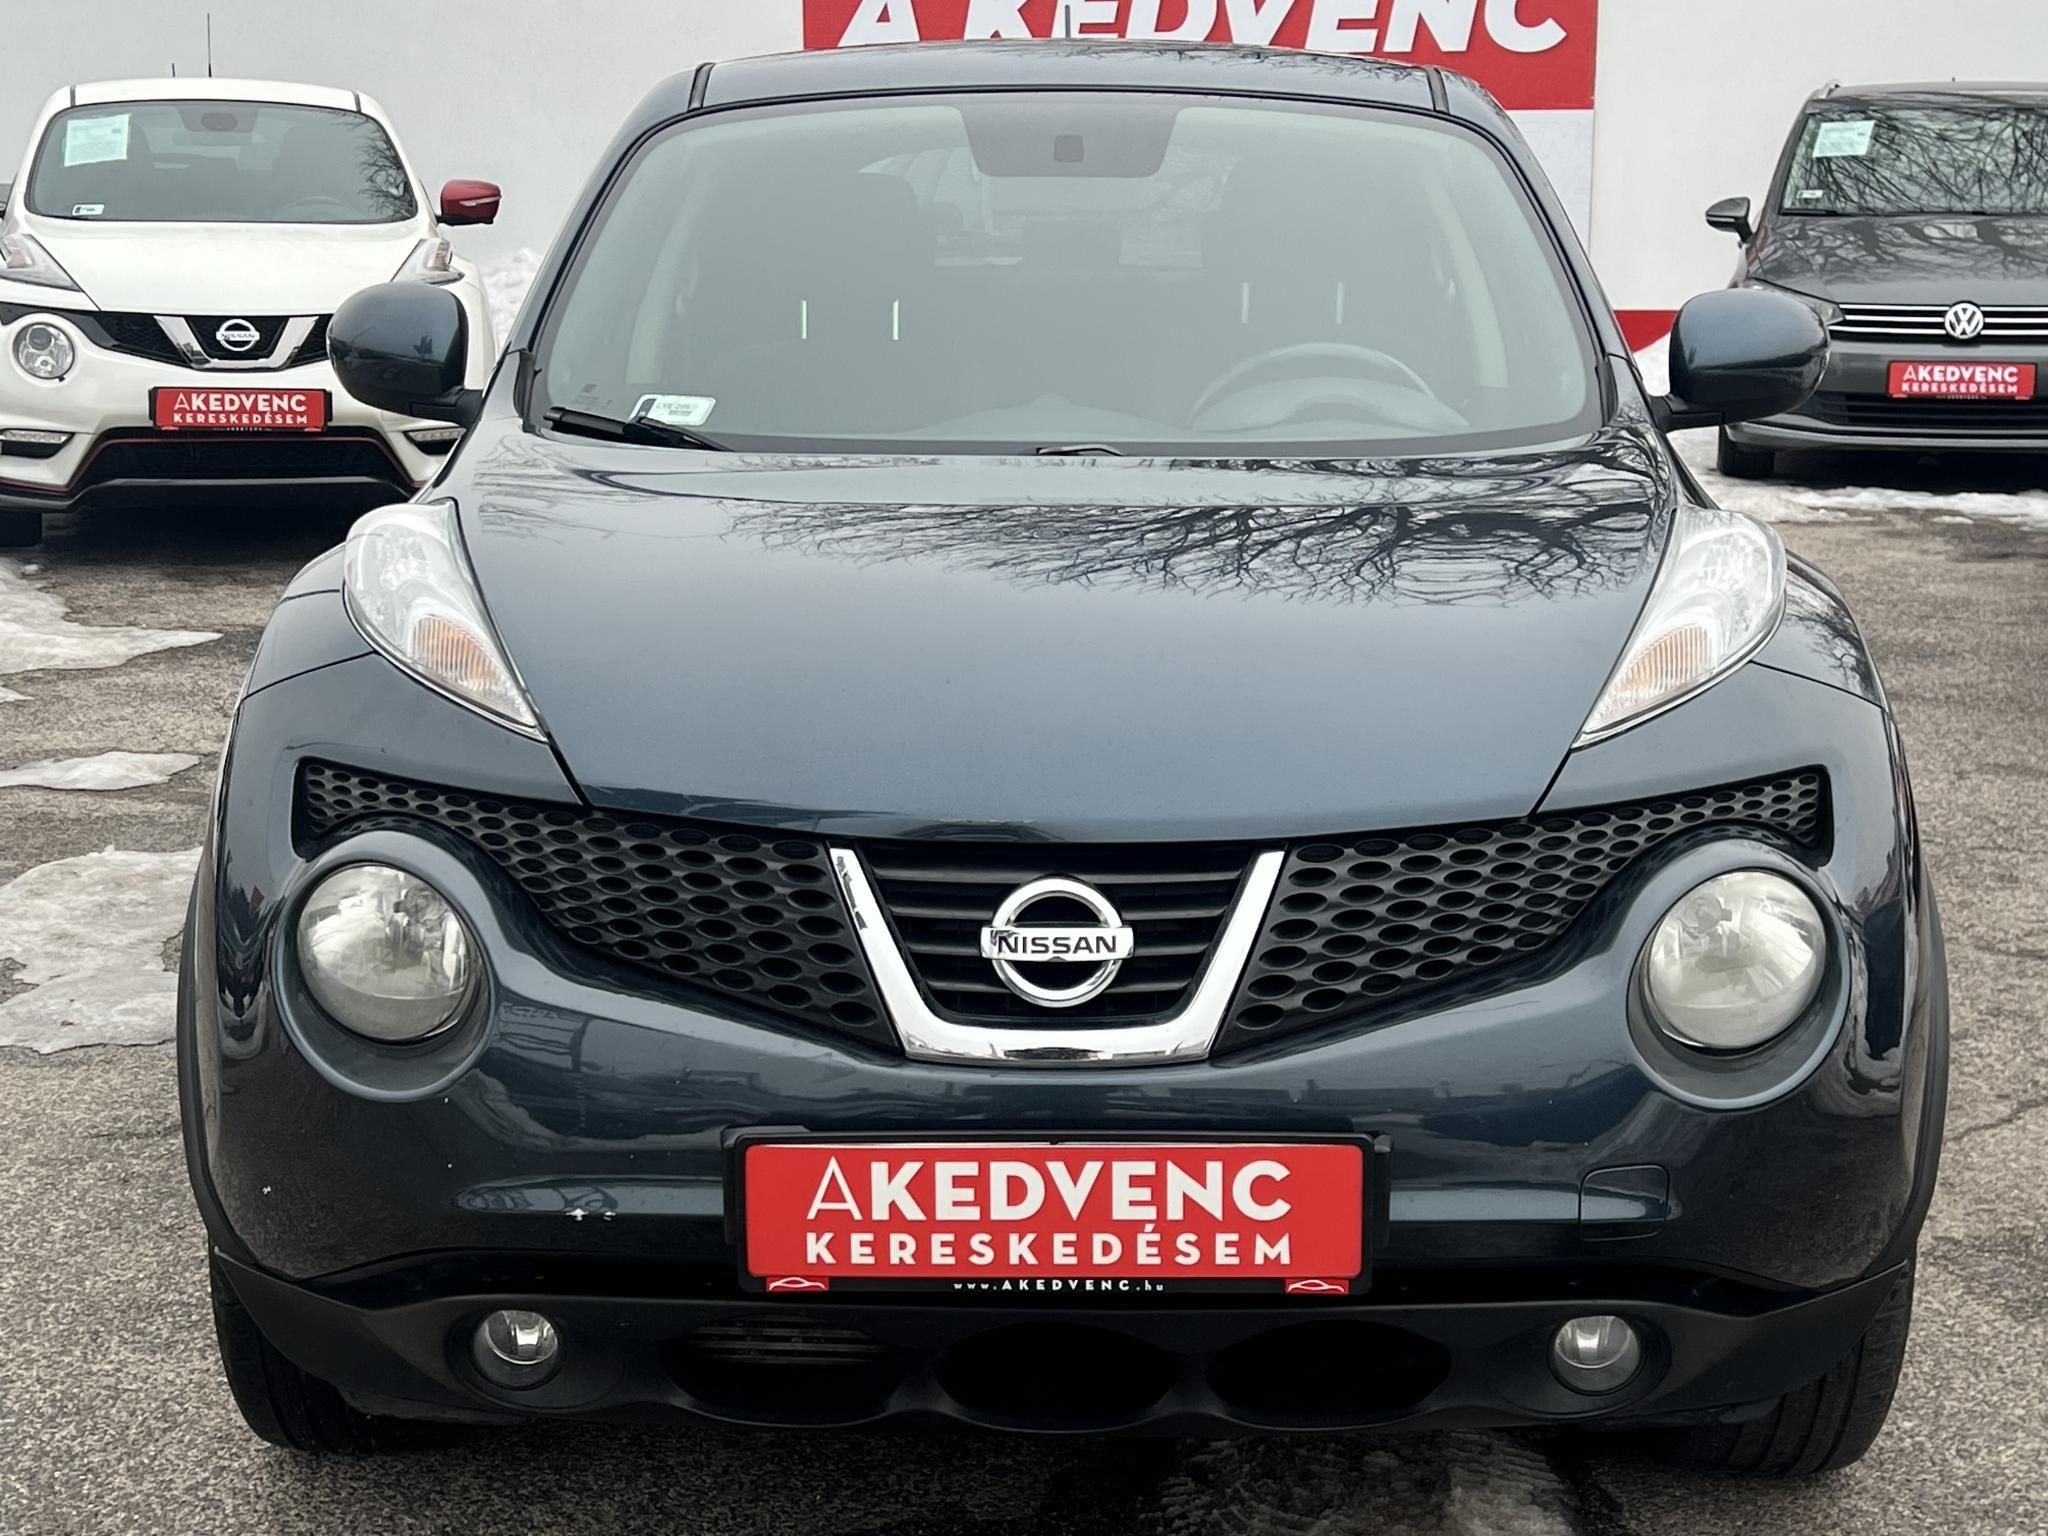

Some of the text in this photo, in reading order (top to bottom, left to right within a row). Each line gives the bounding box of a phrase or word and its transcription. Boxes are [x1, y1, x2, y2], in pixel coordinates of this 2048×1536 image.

[837, 0, 920, 47] A
[1901, 382, 2018, 394] KERESKEDÉSEM
[173, 411, 308, 425] KERESKEDÉSEM
[998, 935, 1117, 955] NISSAN
[806, 1224, 1291, 1265] KERESKEDÉSEM
[953, 1279, 1164, 1291] www.AKEDVENC.hu
